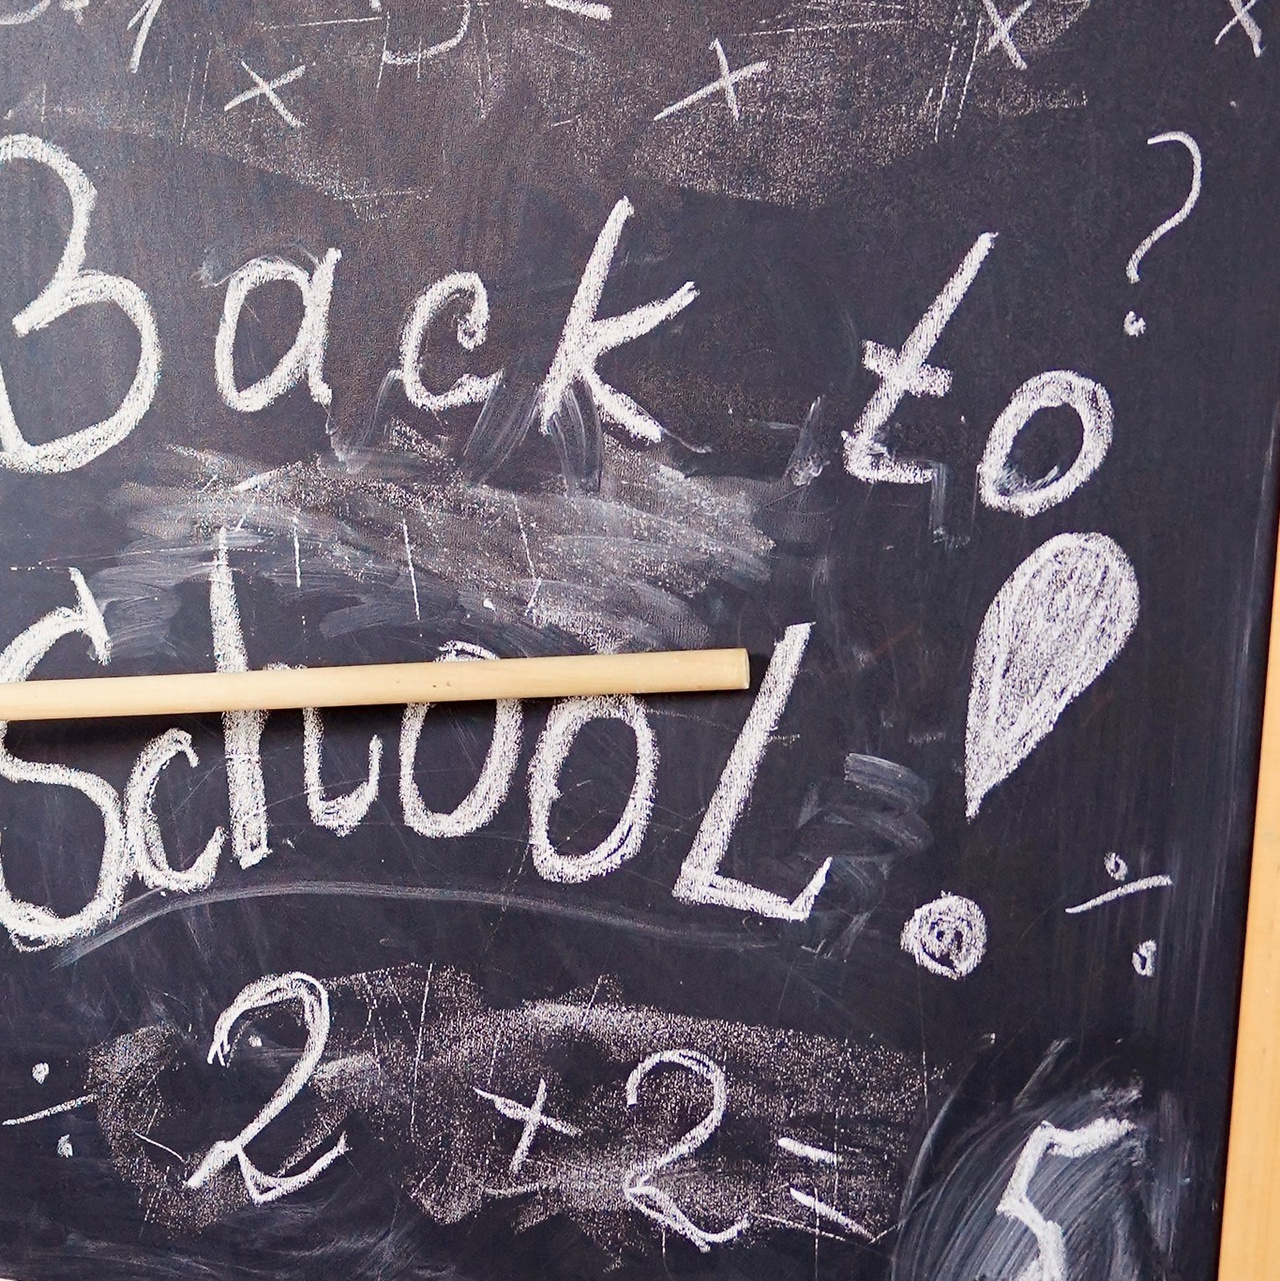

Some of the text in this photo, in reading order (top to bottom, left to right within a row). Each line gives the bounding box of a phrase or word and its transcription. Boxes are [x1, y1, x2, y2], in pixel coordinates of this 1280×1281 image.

[840, 231, 1115, 518] to
[185, 970, 349, 1205] 2
[623, 1048, 752, 1253] 2
